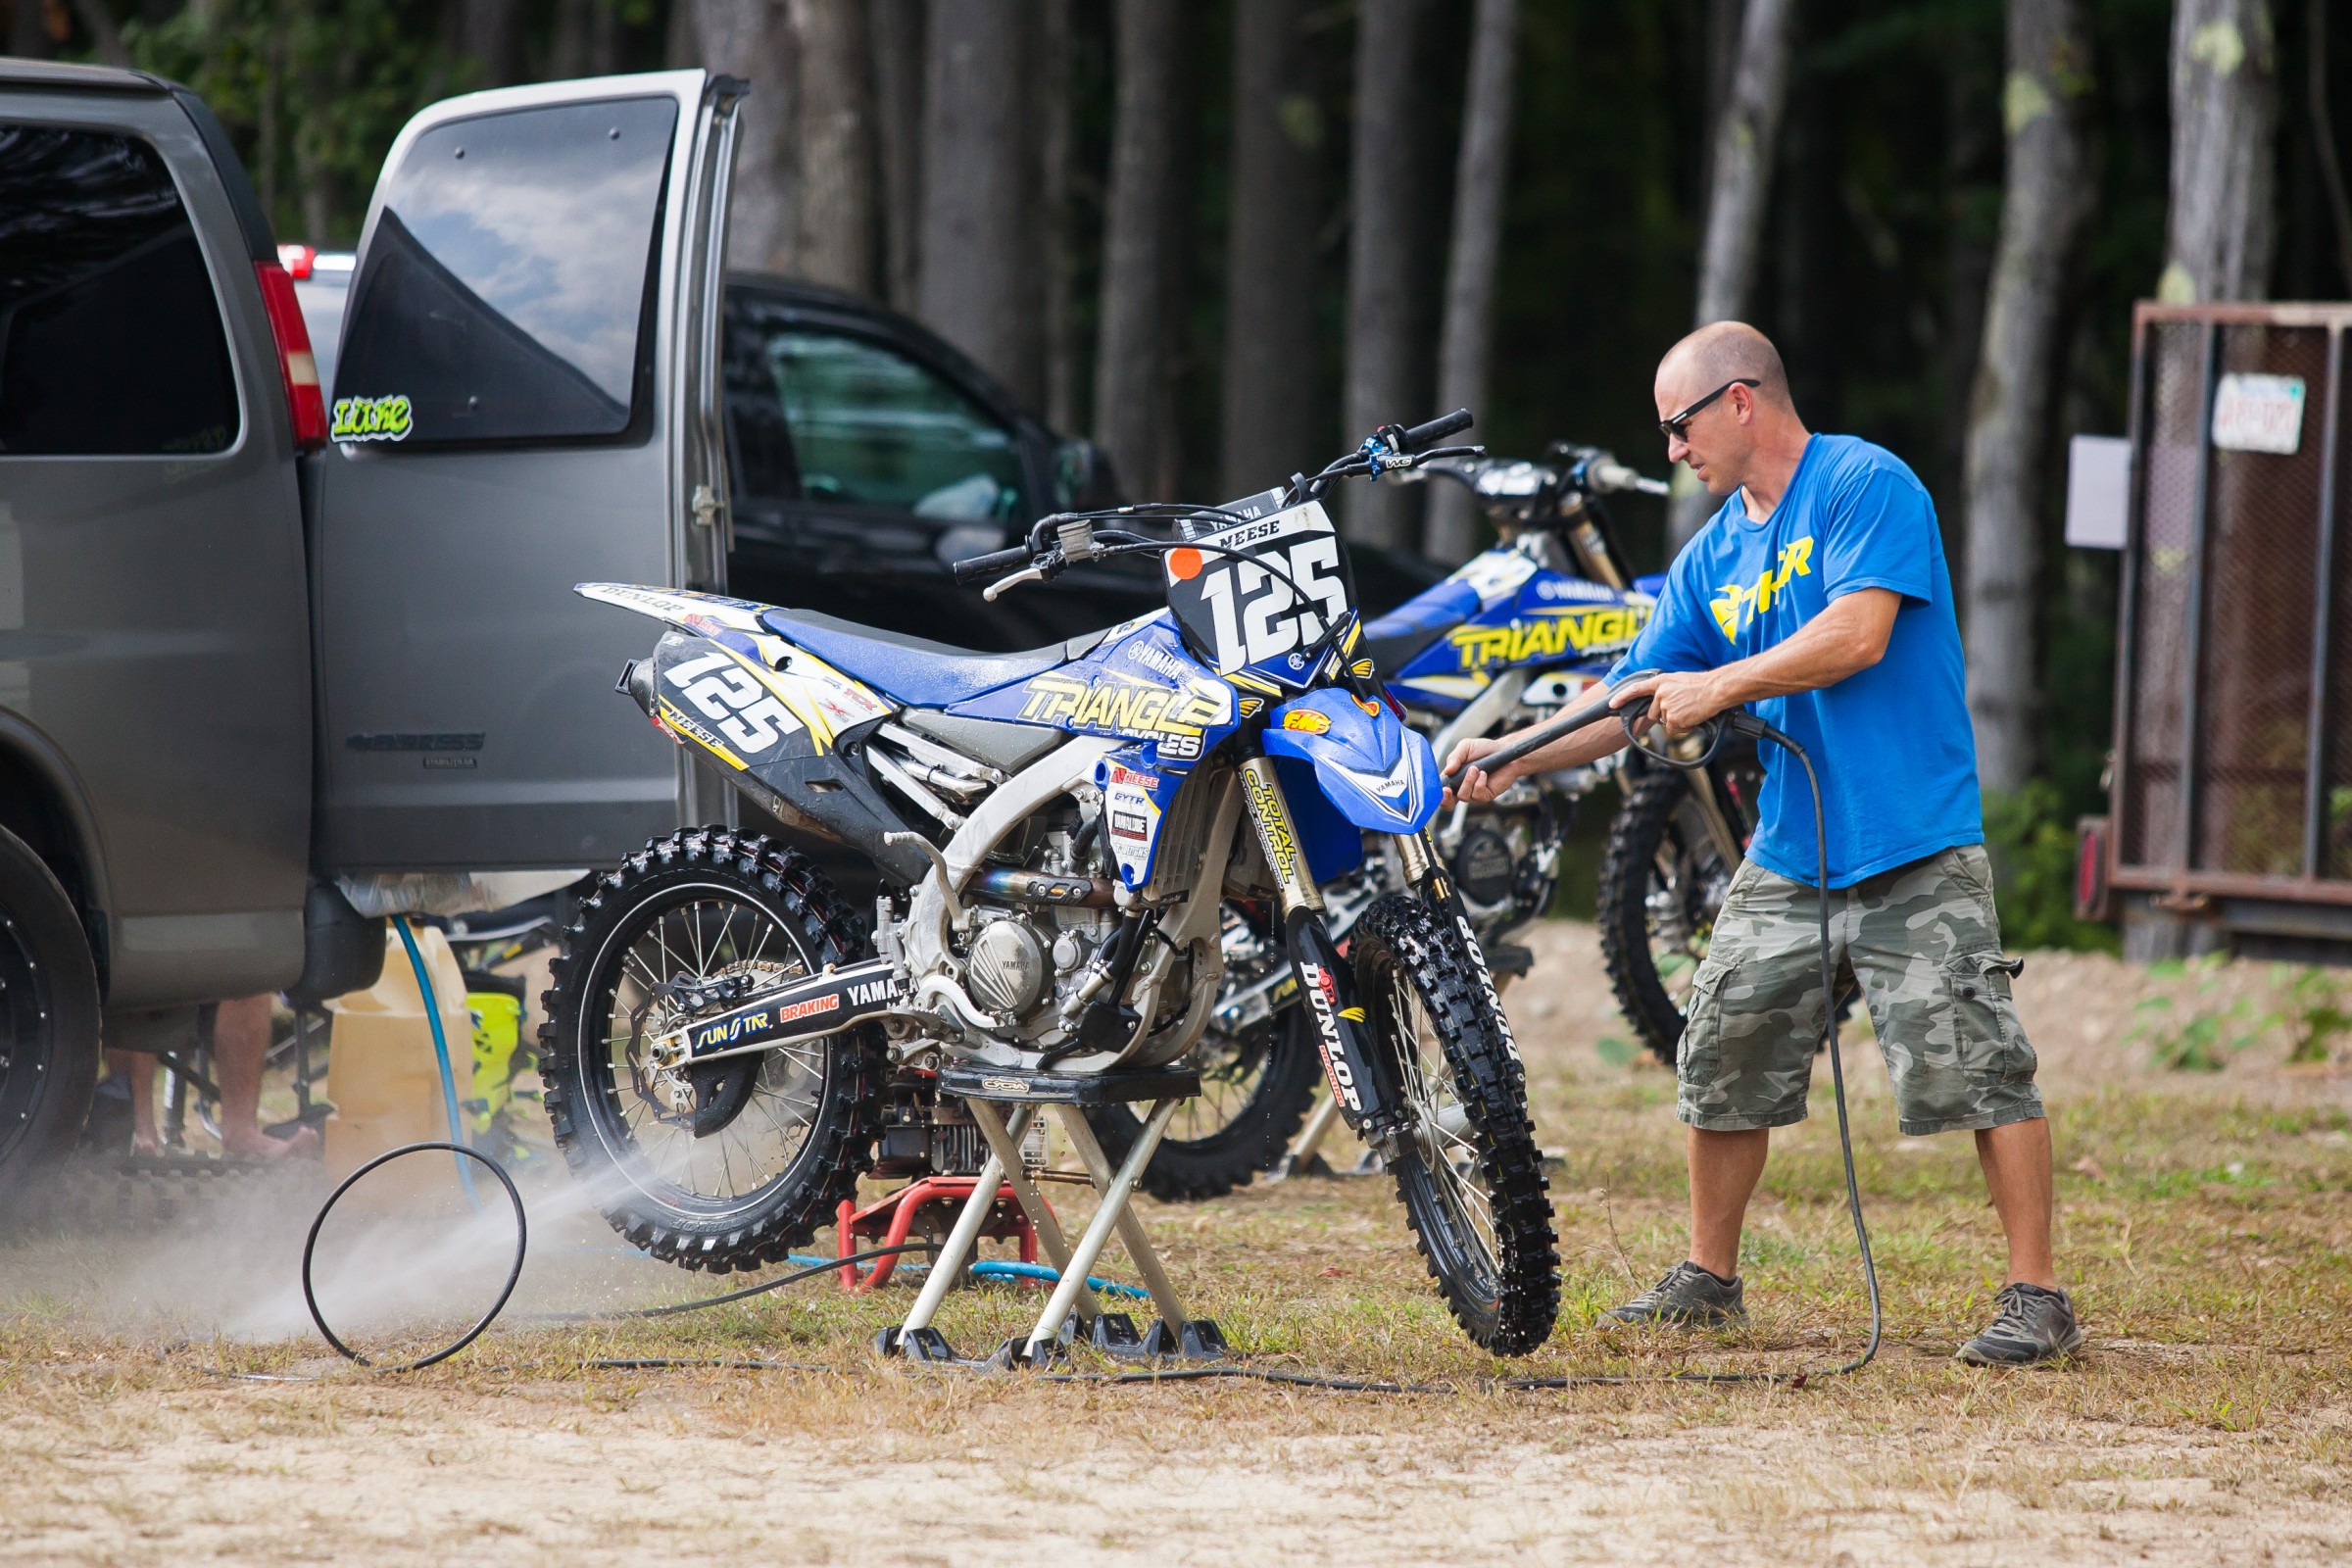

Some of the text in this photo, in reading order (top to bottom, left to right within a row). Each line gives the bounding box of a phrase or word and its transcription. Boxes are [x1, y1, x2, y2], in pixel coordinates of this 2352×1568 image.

[1218, 519, 1281, 550] NEESE
[601, 587, 685, 613] DUNLOP
[1742, 535, 1814, 627] THR
[1200, 535, 1349, 678] 125
[1137, 643, 1184, 681] YAMAHA
[1450, 607, 1652, 668] TRIANGL
[662, 651, 805, 755] 125
[1020, 676, 1222, 736] TRIANGLE
[668, 709, 726, 748] NEESE
[1114, 793, 1146, 805] GYTR
[1124, 772, 1160, 788] NEESE
[1375, 779, 1406, 793] YAMAHA
[1245, 768, 1295, 884] CONTROL
[1263, 783, 1297, 861] TOTAL
[780, 994, 840, 1023] BRAKING
[847, 976, 919, 1006] YAMAA
[1299, 961, 1362, 1111] DUNLOP
[1318, 1045, 1346, 1107] BRAKING
